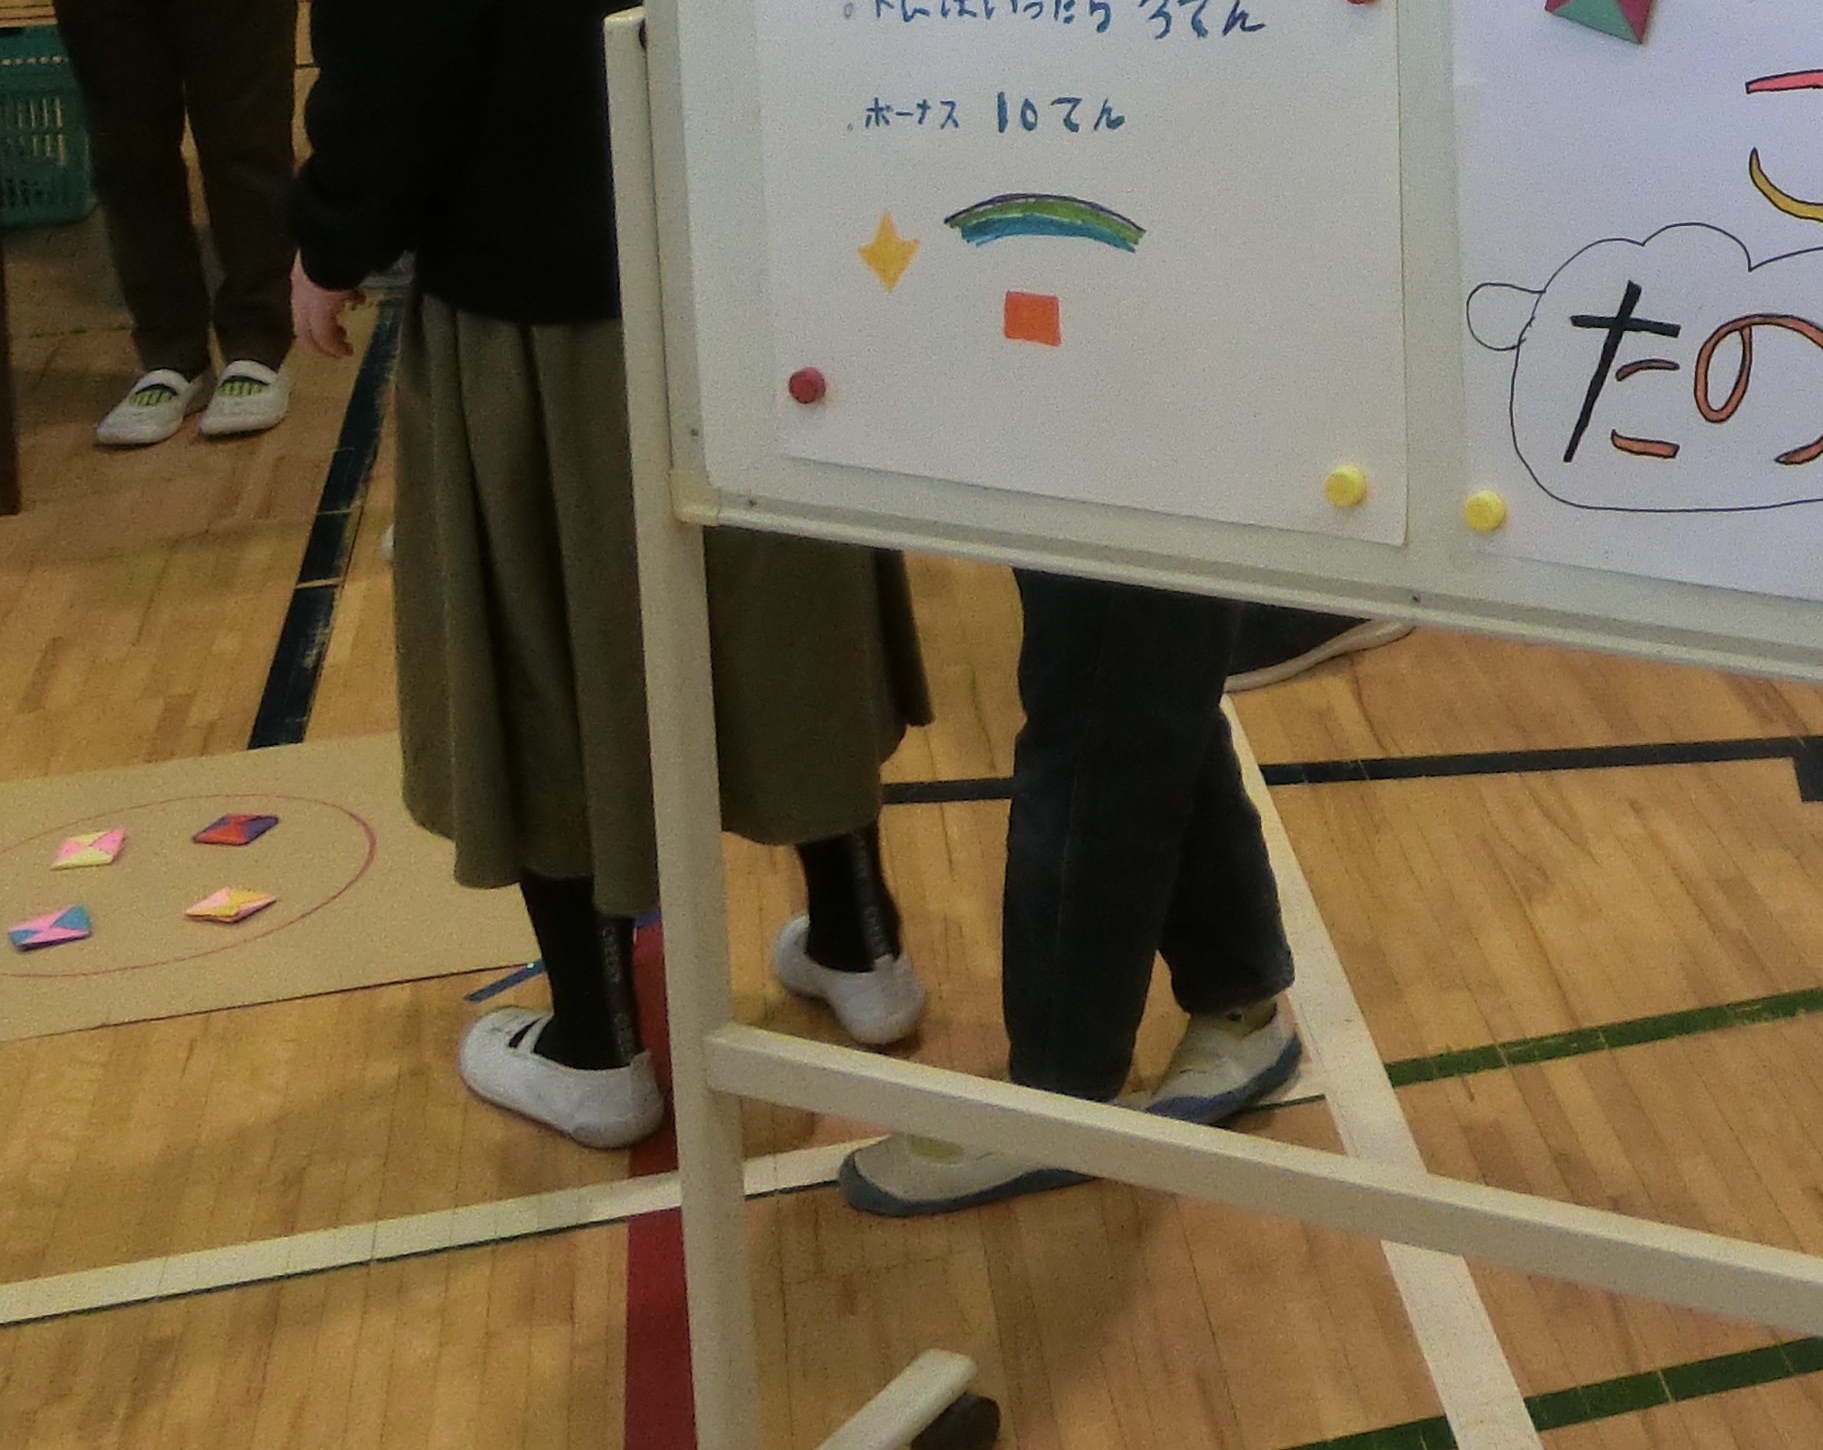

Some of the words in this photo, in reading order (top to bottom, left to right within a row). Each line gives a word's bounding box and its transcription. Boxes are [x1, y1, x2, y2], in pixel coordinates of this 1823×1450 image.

[864, 96, 961, 131] ボーナス
[997, 91, 1126, 134] 10てん
